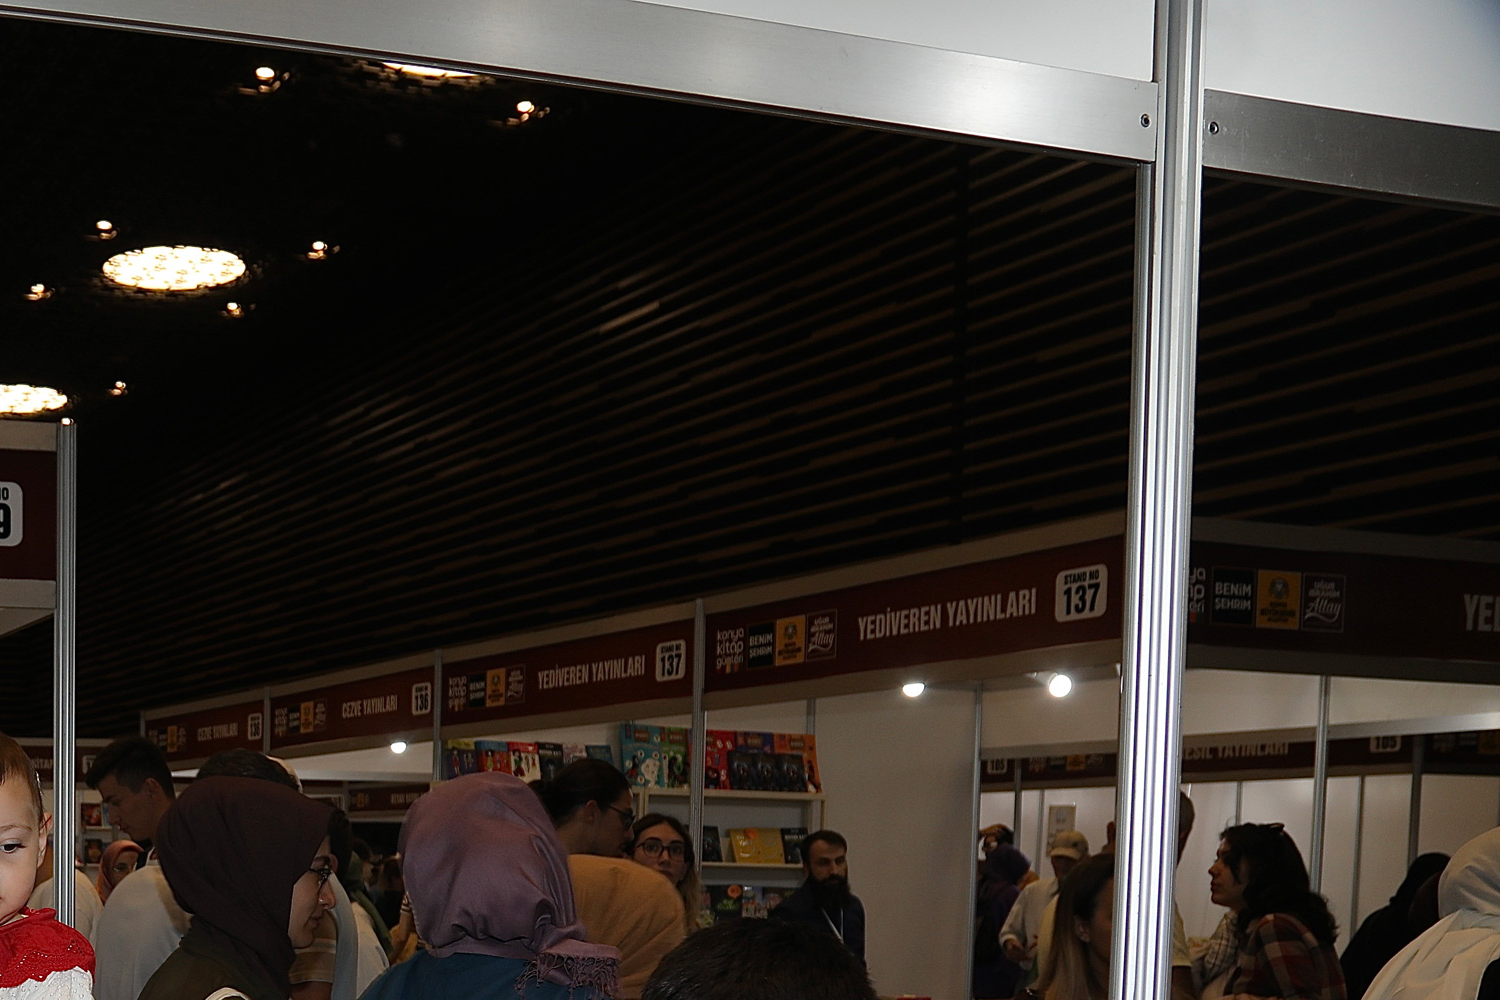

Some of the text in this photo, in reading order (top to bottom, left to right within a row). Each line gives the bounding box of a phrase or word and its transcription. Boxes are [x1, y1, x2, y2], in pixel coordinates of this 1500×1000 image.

[1063, 569, 1100, 585] STAND NO
[1063, 584, 1100, 616] 137
[857, 587, 1038, 642] YEDİVEREN YAYINLARI
[538, 664, 590, 691] YEDİVEREN
[591, 655, 646, 682] YAYINLARI
[660, 654, 682, 677] 137
[341, 694, 398, 719] CEZVE YAYINLARI
[1375, 736, 1398, 750] 105
